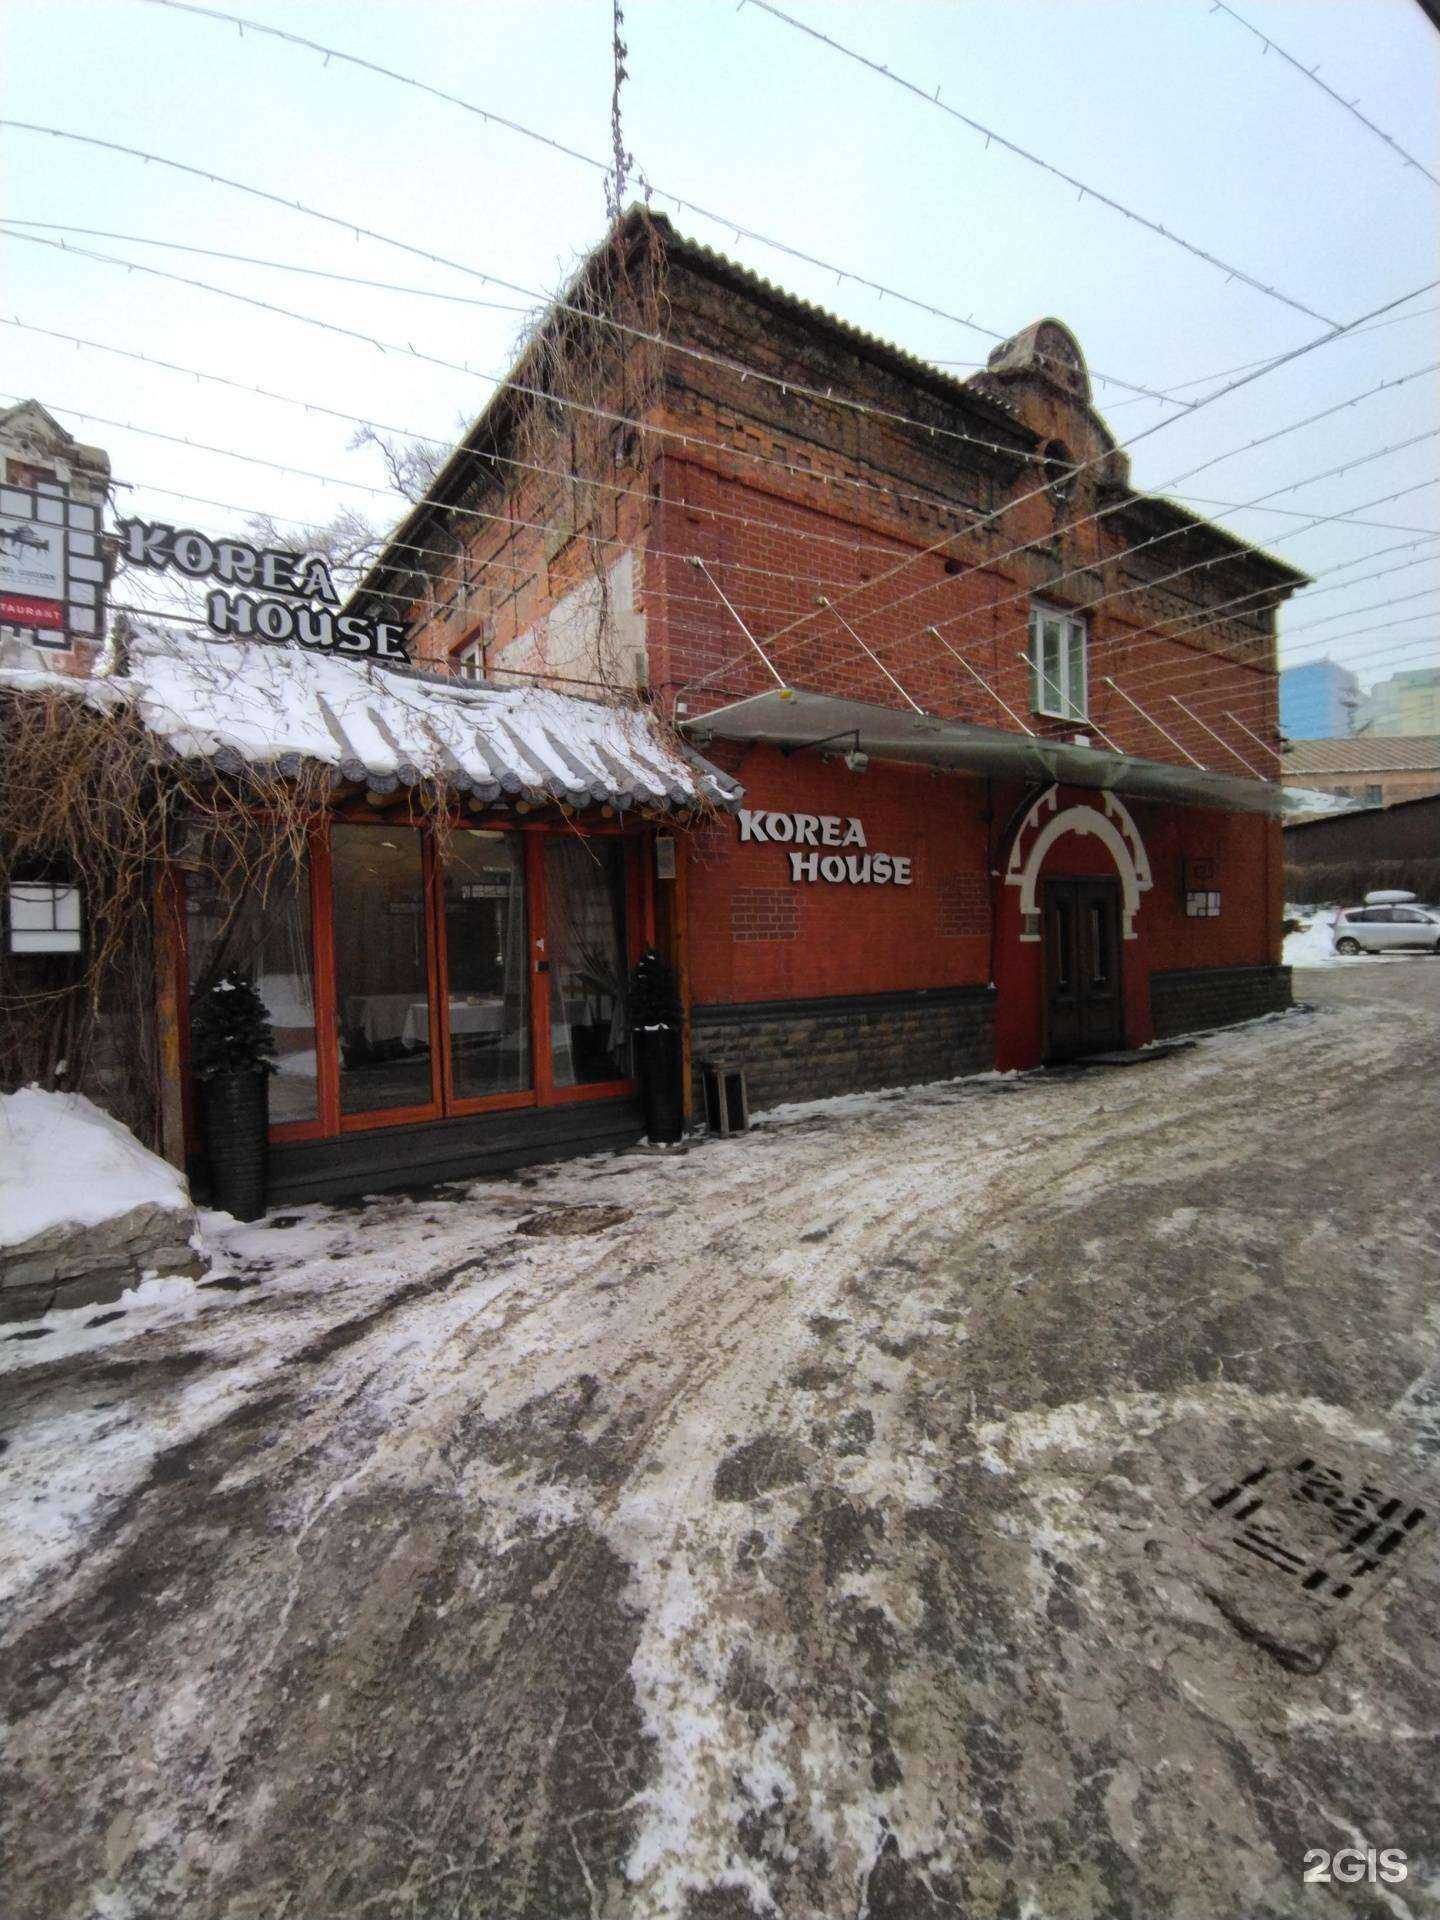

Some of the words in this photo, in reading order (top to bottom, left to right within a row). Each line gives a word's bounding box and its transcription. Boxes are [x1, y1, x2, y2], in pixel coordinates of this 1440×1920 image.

[120, 519, 339, 604] KOREA
[208, 590, 409, 662] HOUSE
[738, 809, 867, 848] KOREA
[789, 852, 913, 886] HOUSE
